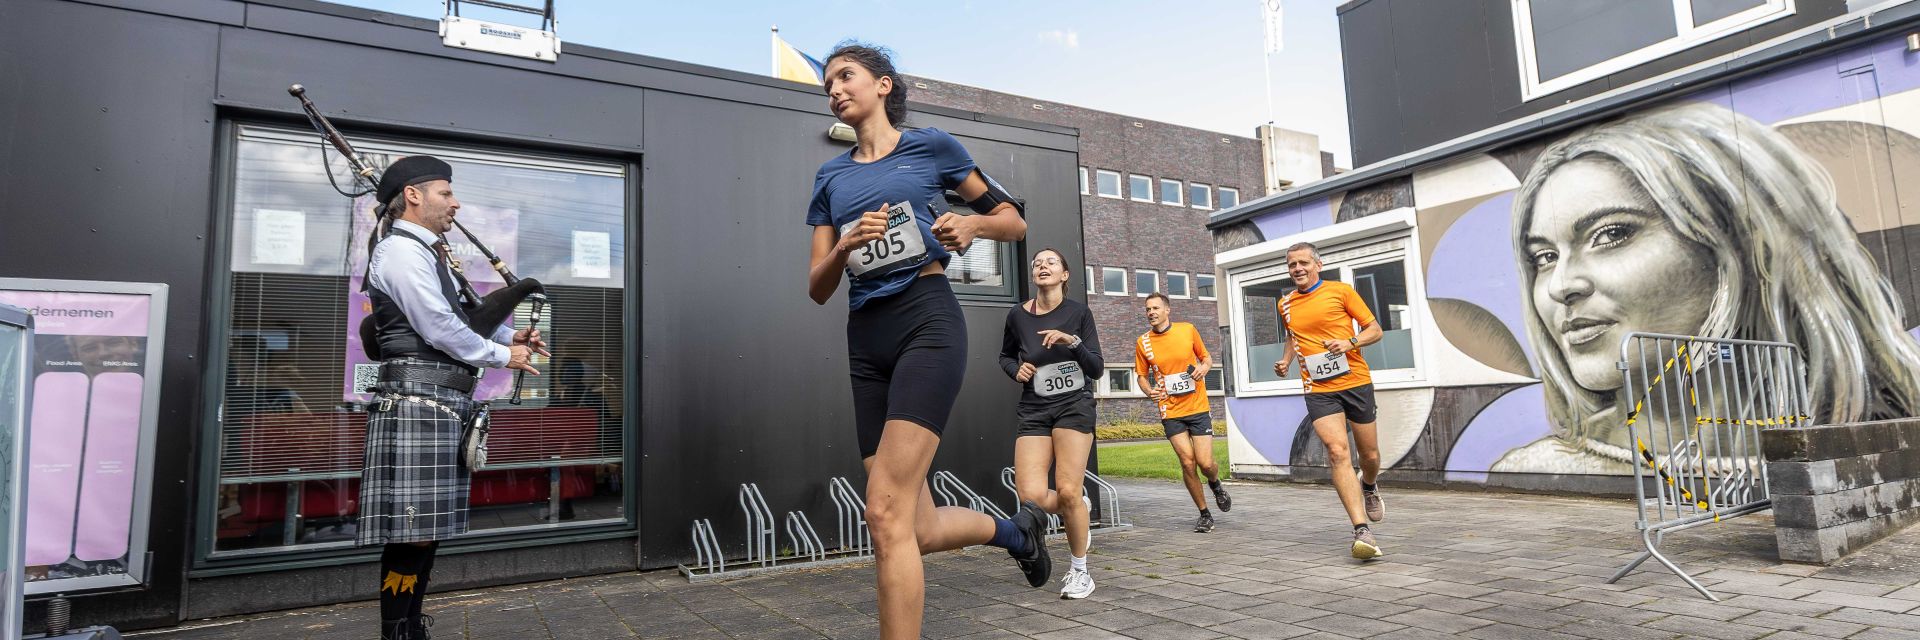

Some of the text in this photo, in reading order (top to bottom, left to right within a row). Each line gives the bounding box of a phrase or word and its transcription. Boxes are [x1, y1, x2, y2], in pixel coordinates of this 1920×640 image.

[888, 213, 910, 228] RAIL
[861, 231, 905, 265] 305
[31, 306, 114, 318] dernemen
[1316, 361, 1340, 375] 454
[1045, 375, 1074, 391] 306
[1172, 381, 1190, 391] 453
